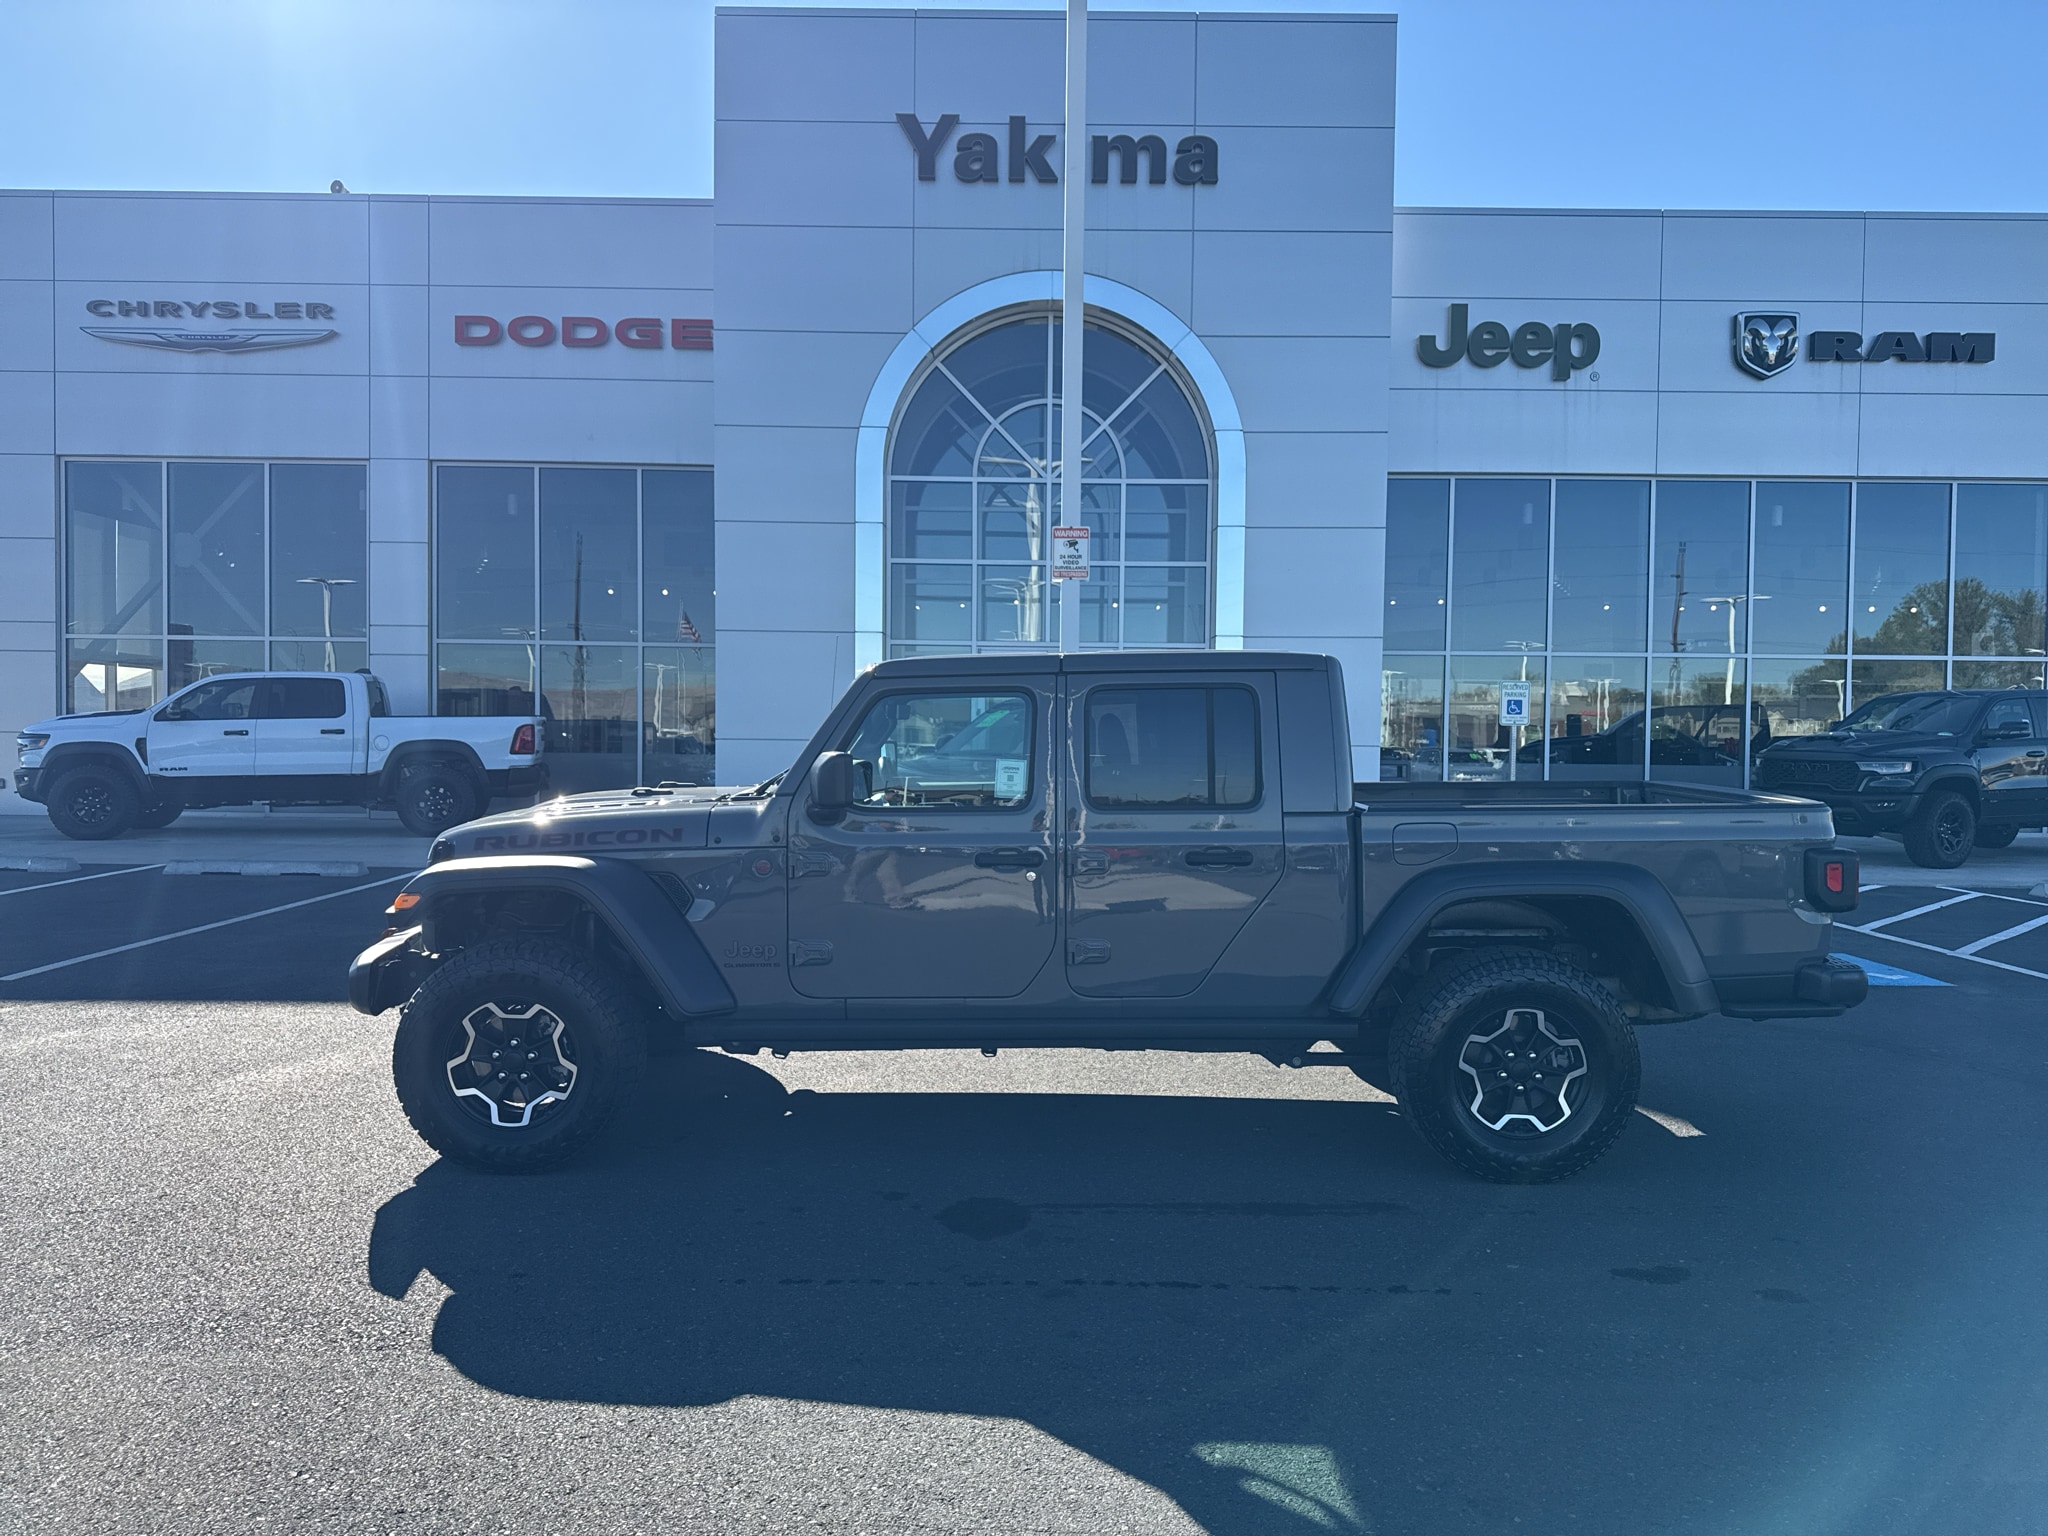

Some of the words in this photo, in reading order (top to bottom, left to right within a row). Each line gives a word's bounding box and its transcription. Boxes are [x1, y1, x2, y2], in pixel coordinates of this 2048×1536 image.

[895, 112, 1219, 186] Yakma
[85, 298, 337, 321] CHRYSLER
[454, 314, 713, 351] DODGE
[1417, 303, 1601, 380] Jeep
[1808, 330, 1996, 363] RAM
[474, 827, 684, 851] RUBICON
[724, 940, 777, 962] Jeep
